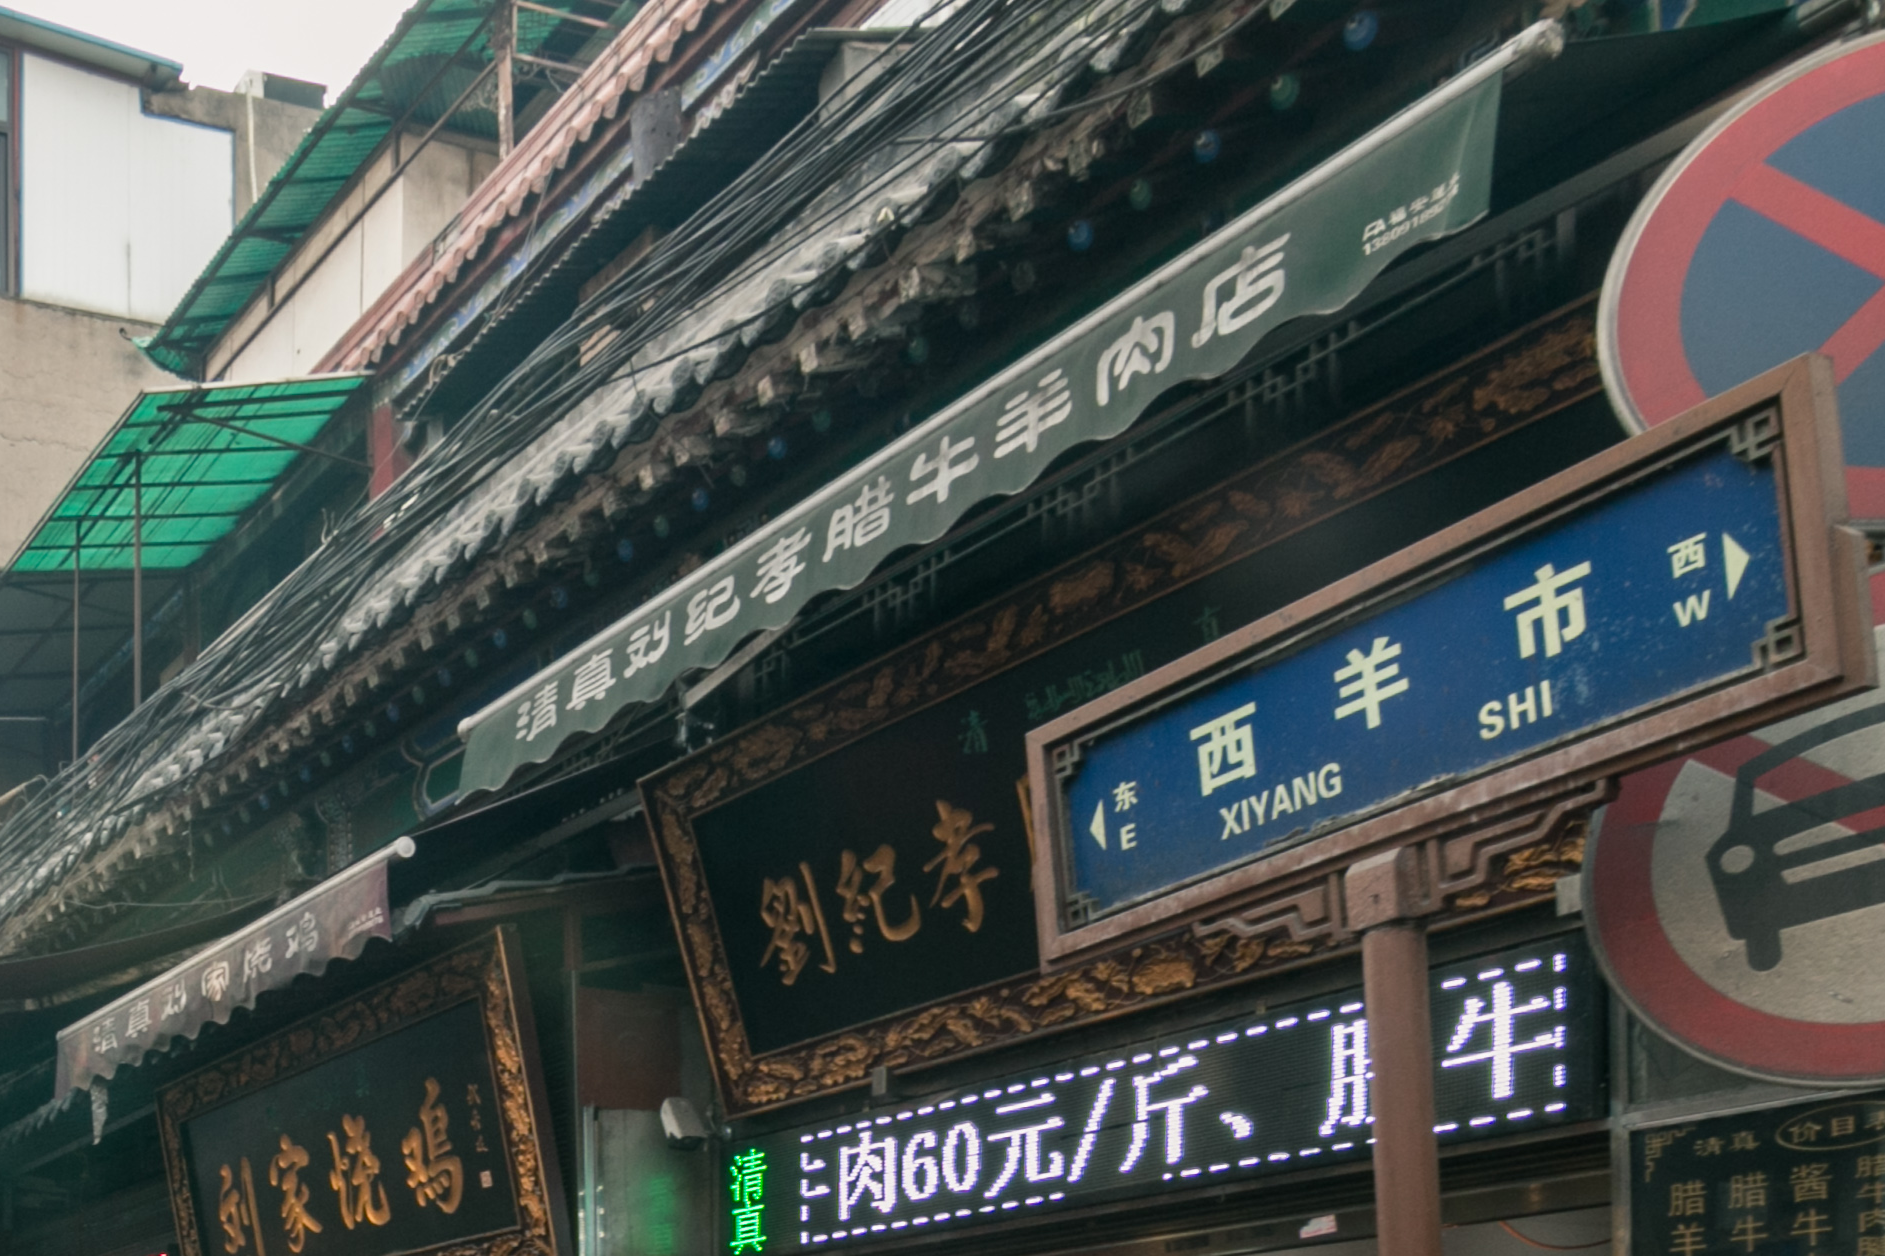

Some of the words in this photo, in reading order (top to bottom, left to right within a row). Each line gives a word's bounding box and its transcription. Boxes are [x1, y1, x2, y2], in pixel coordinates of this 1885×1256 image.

[515, 232, 1292, 742] 清真刘纪孝腊牛羊肉店
[1667, 532, 1707, 578] 西
[1673, 590, 1711, 628] W
[1190, 560, 1592, 797] 西羊市
[1113, 780, 1139, 813] 东
[1219, 761, 1344, 841] XIYANG
[1478, 678, 1555, 741] SHI
[759, 778, 1038, 986] 劉紀孝
[1120, 822, 1138, 852] E
[731, 1149, 767, 1255] 清真
